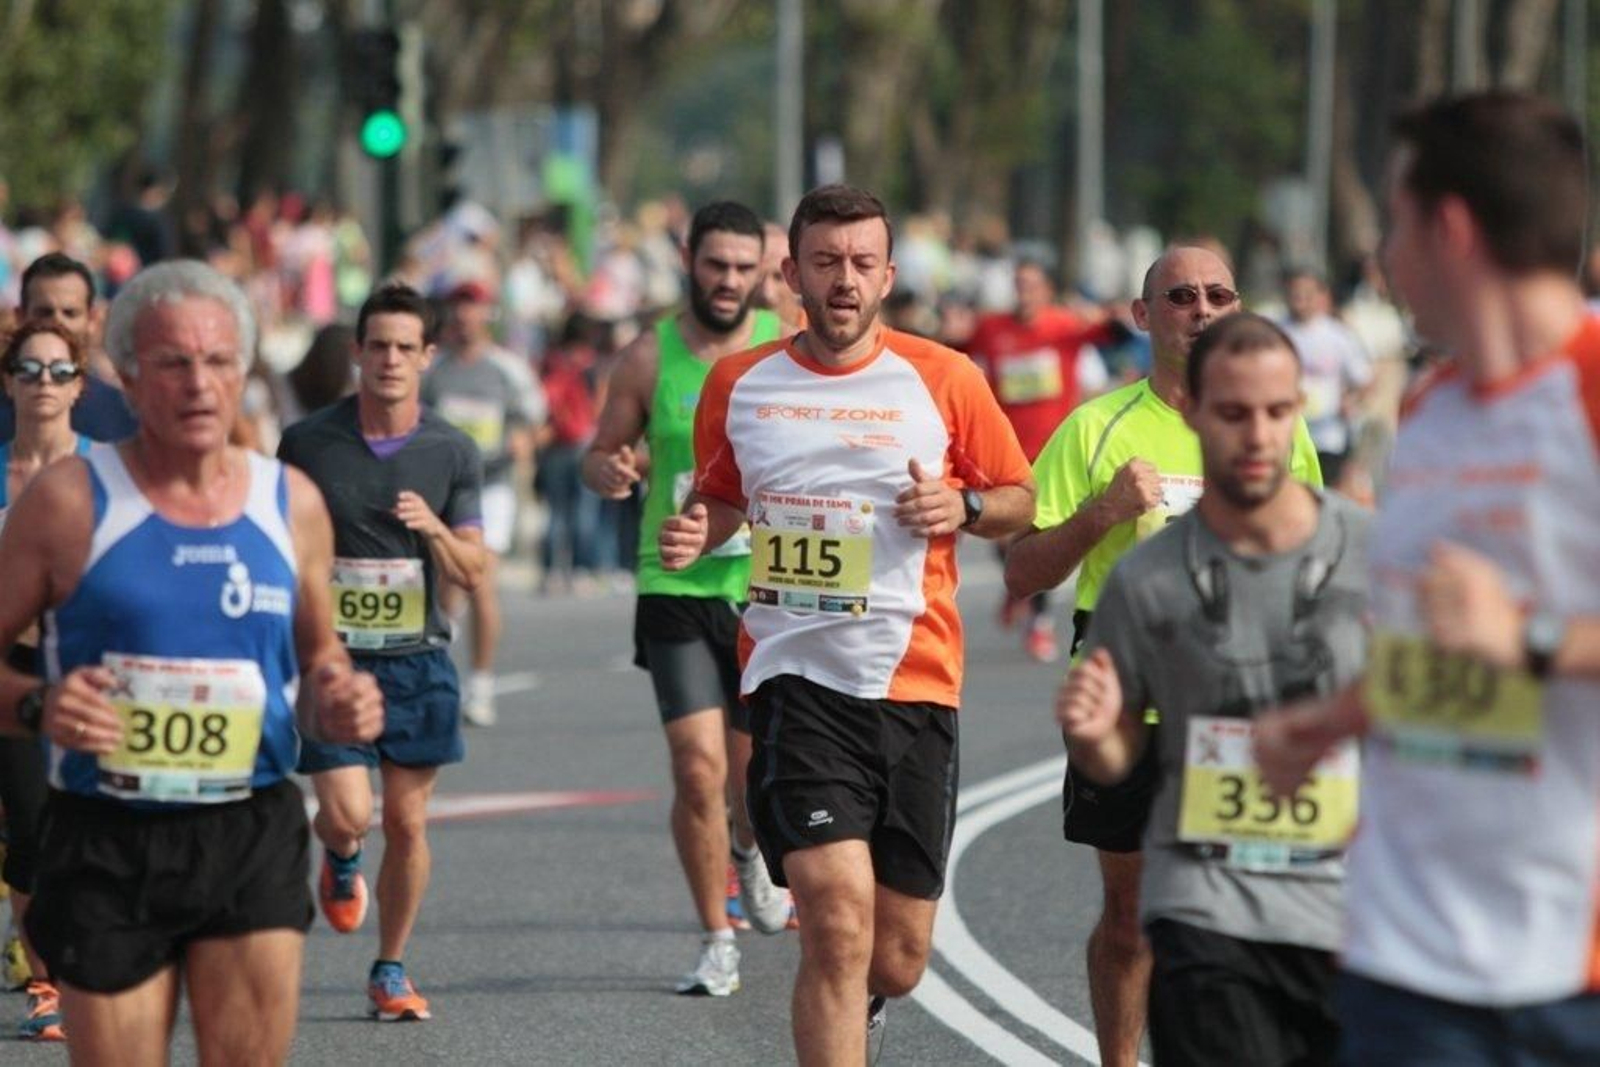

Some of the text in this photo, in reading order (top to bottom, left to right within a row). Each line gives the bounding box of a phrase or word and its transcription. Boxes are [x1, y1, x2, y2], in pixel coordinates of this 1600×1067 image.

[756, 405, 903, 422] SPORT ZONE
[768, 534, 842, 578] 115
[339, 590, 403, 621] 699
[127, 708, 228, 757] 308
